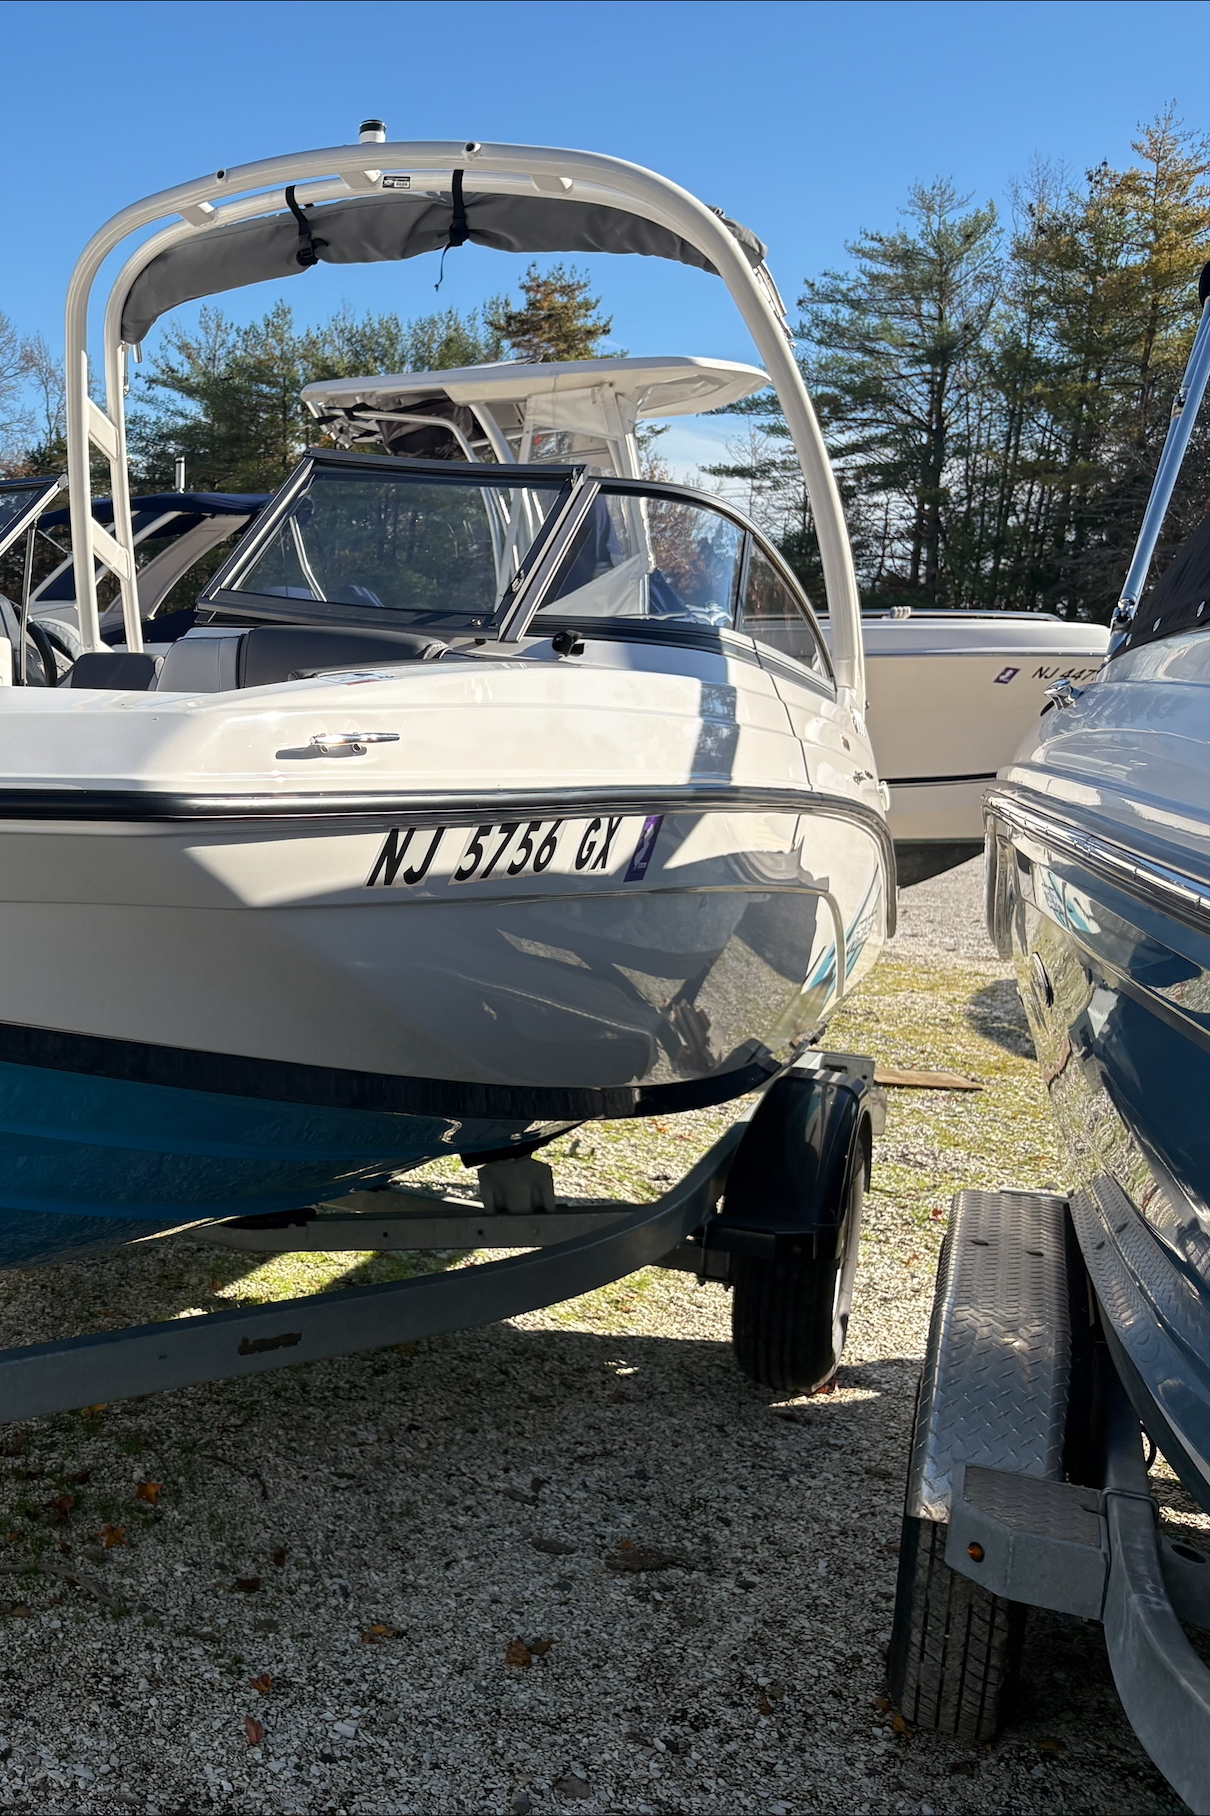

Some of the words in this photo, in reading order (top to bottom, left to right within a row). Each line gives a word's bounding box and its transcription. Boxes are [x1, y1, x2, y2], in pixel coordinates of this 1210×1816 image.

[1031, 666, 1060, 679] NJ
[1060, 668, 1099, 681] 447
[366, 827, 446, 887] NJ
[453, 819, 565, 882] 5756
[575, 816, 624, 871] GX
